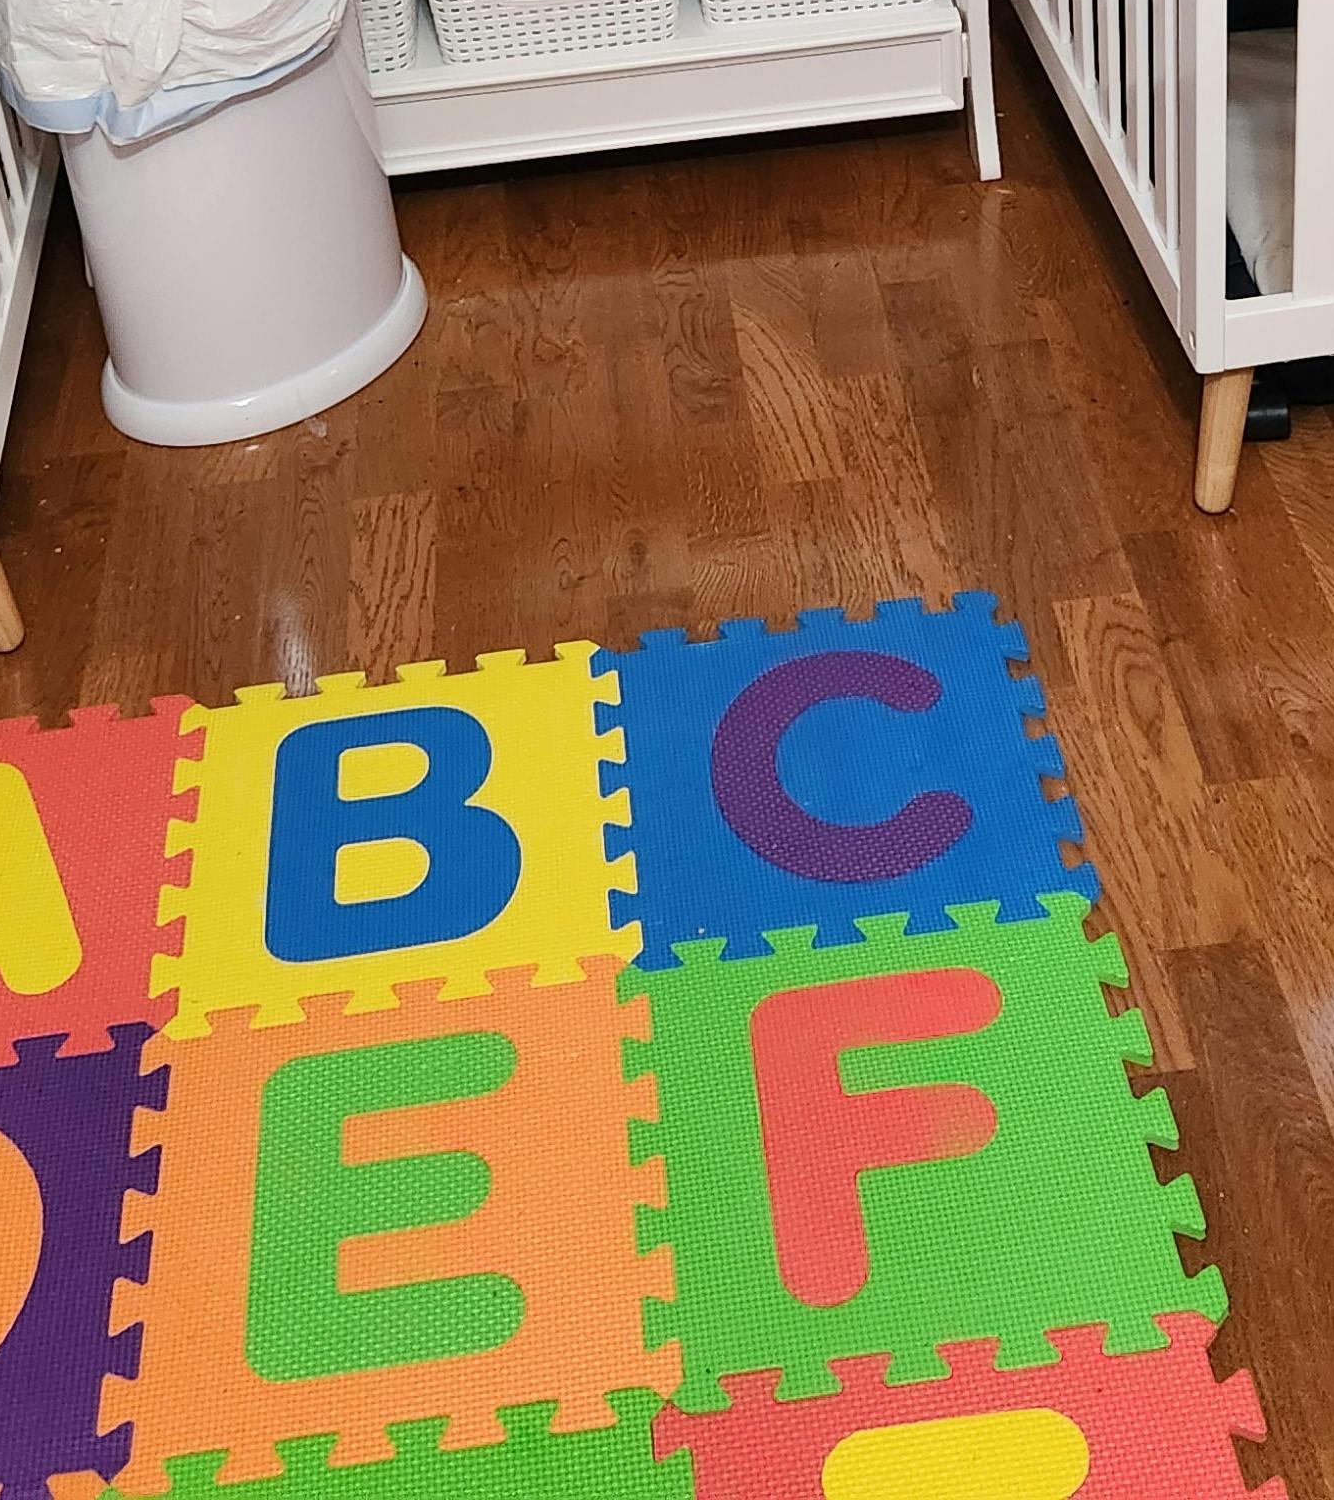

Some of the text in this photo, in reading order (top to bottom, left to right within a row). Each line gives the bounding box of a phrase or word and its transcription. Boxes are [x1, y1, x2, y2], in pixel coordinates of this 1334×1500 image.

[265, 706, 523, 963] B
[710, 650, 974, 885] C
[244, 1031, 525, 1384] E
[751, 968, 1005, 1310] F
